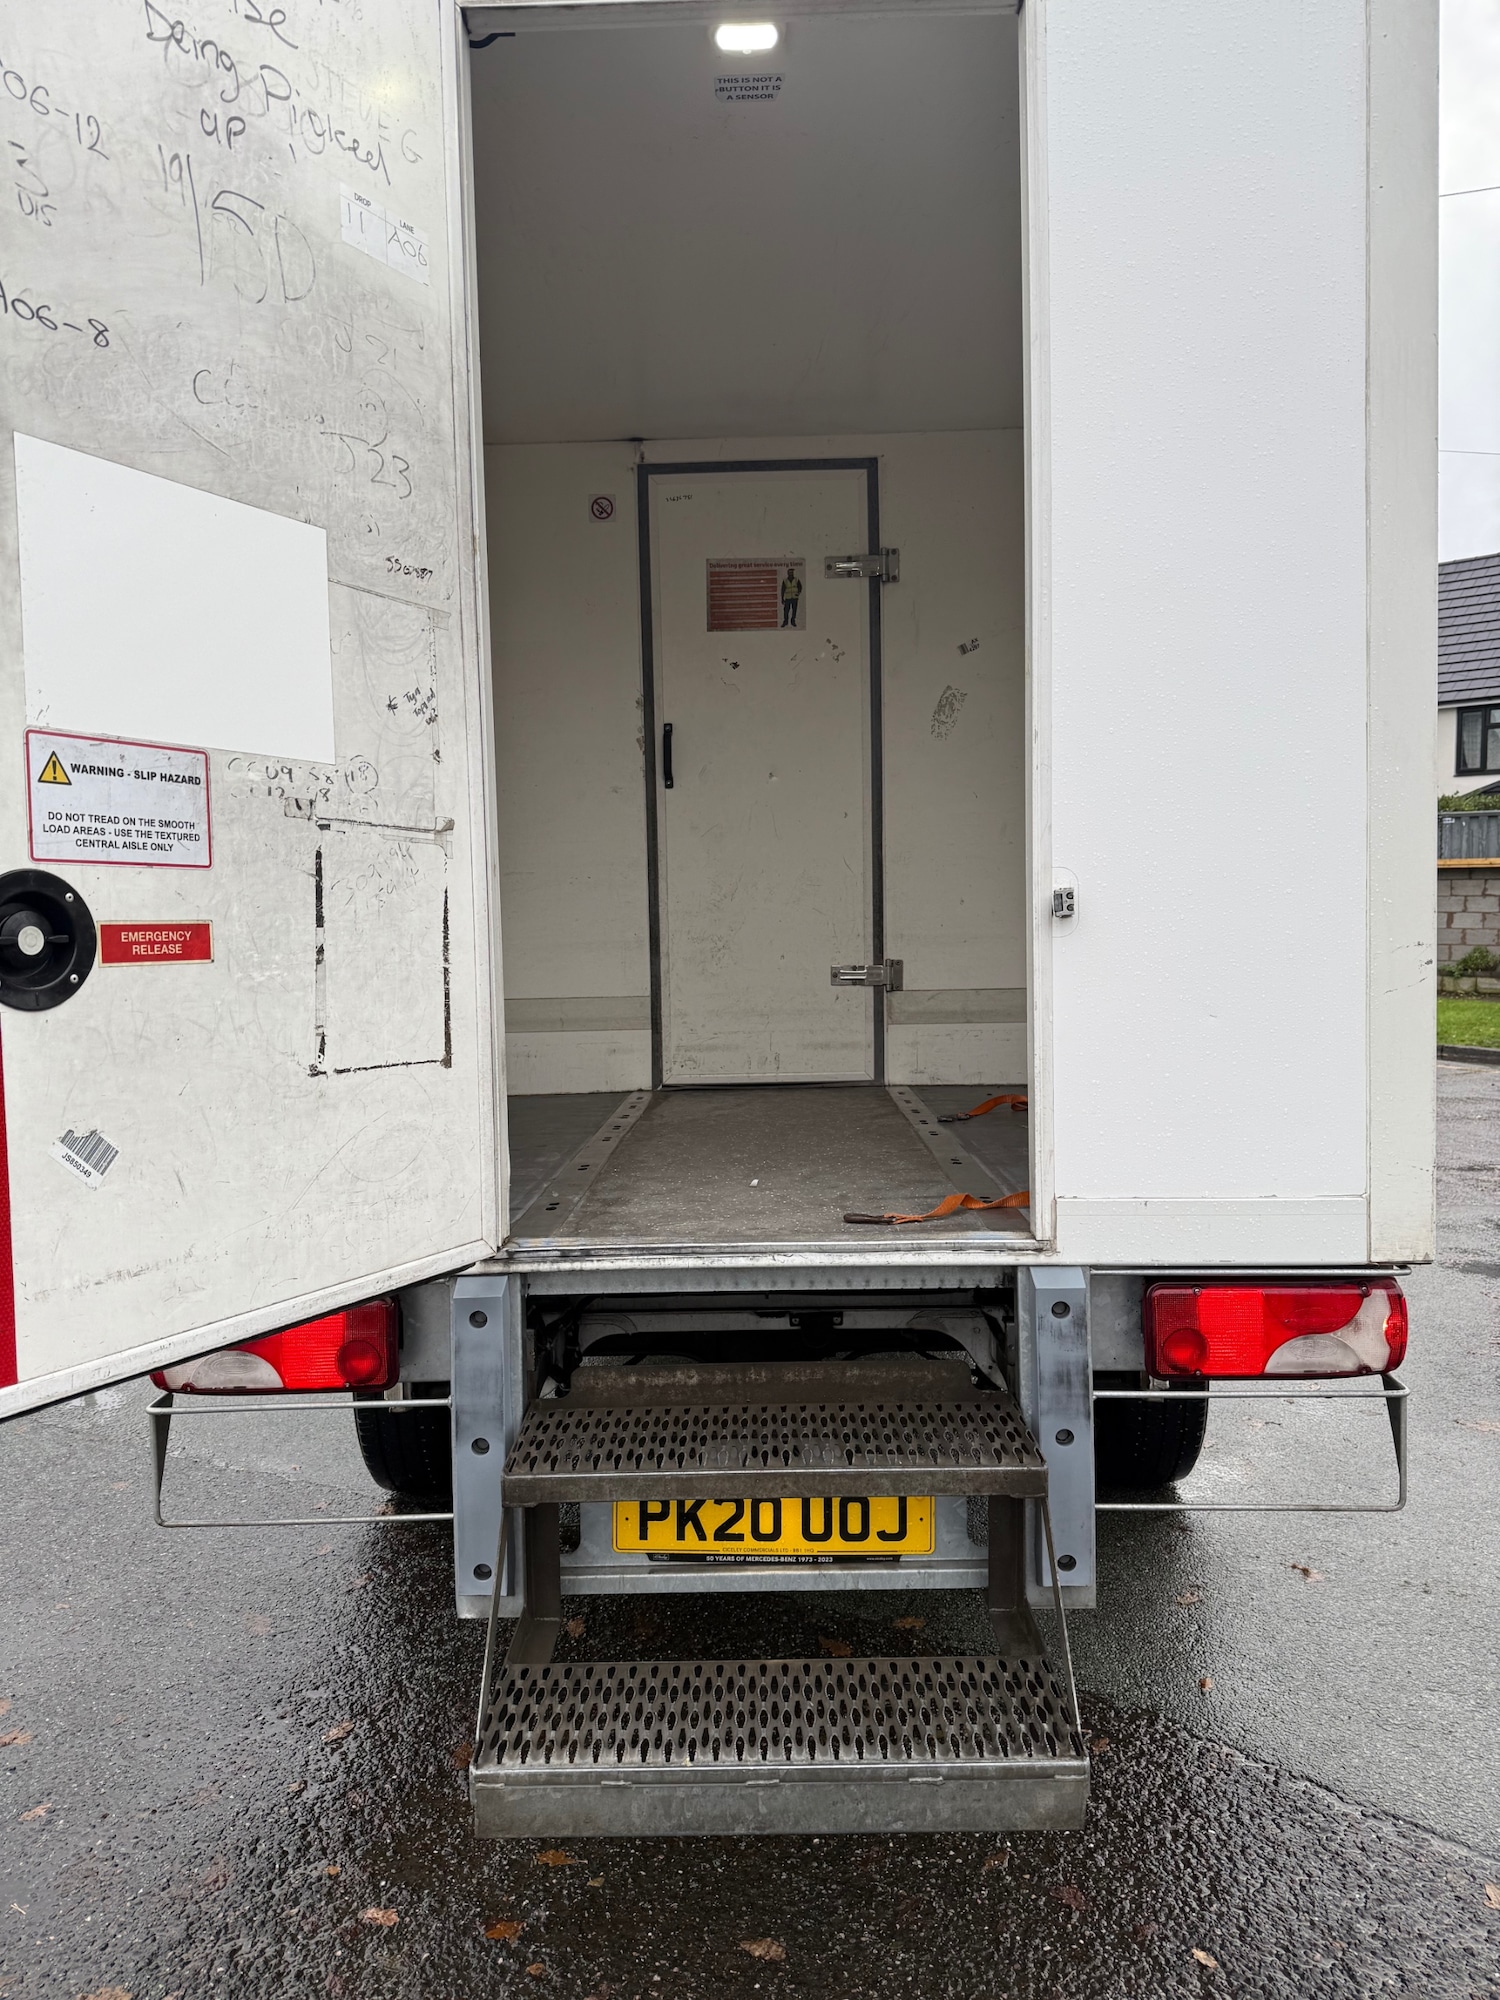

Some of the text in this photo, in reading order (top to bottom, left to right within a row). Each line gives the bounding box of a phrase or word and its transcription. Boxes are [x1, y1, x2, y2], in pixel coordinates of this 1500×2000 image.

[354, 192, 371, 207] DROP
[399, 219, 415, 235] LANE
[387, 226, 427, 266] A06
[70, 763, 124, 778] WARNING
[134, 770, 157, 781] SLIP
[160, 773, 201, 786] HAZARD
[48, 811, 195, 830] DO NOT TREAD ON THE SMOOTH
[43, 824, 70, 834] LOAD
[73, 826, 106, 836] AREAS
[114, 828, 133, 838] USE
[135, 829, 152, 839] THE
[155, 831, 201, 842] TEXTURED
[75, 838, 174, 852] CENTRAL AISLE ONLY
[121, 931, 192, 942] EMERGENCY
[132, 944, 183, 955] RELEASE
[61, 1152, 92, 1178] JS850349
[639, 1497, 782, 1541] PK20
